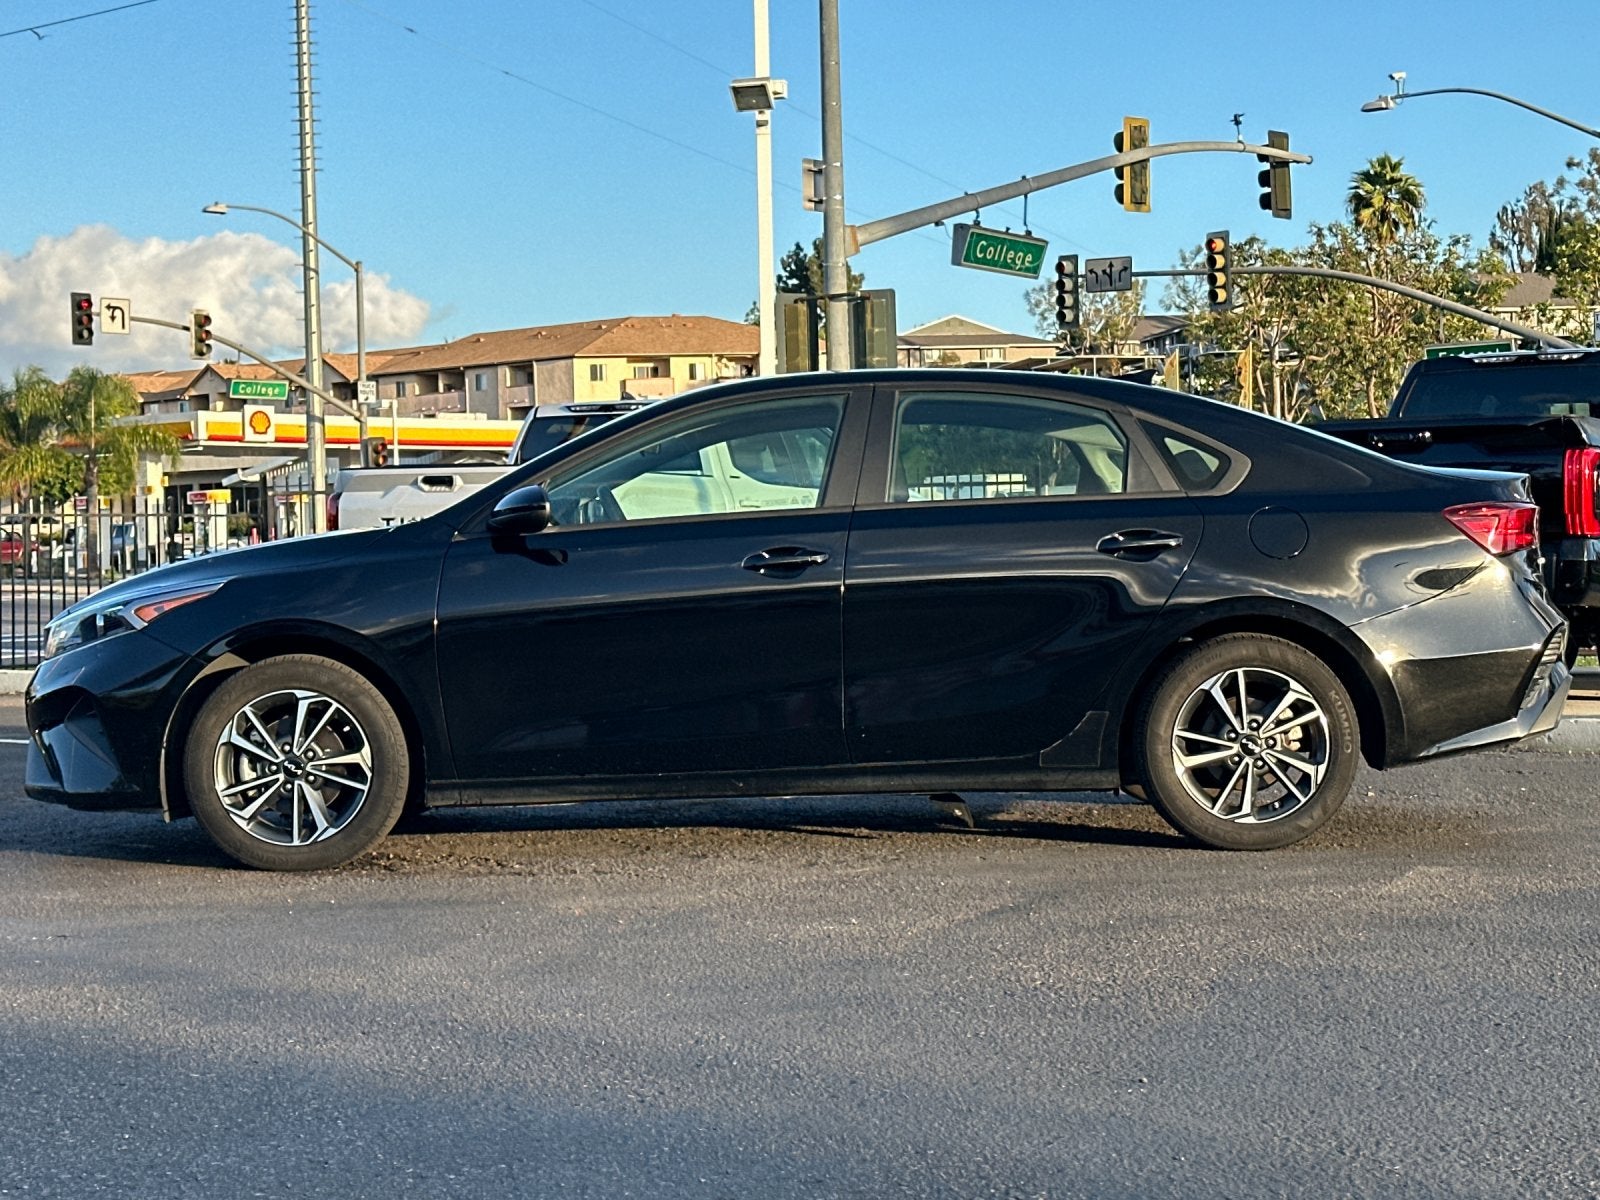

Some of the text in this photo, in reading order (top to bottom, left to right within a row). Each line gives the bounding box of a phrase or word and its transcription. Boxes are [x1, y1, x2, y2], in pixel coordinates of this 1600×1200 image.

[976, 240, 1033, 270] College
[238, 384, 281, 397] College
[1328, 689, 1352, 754] KUMHO
